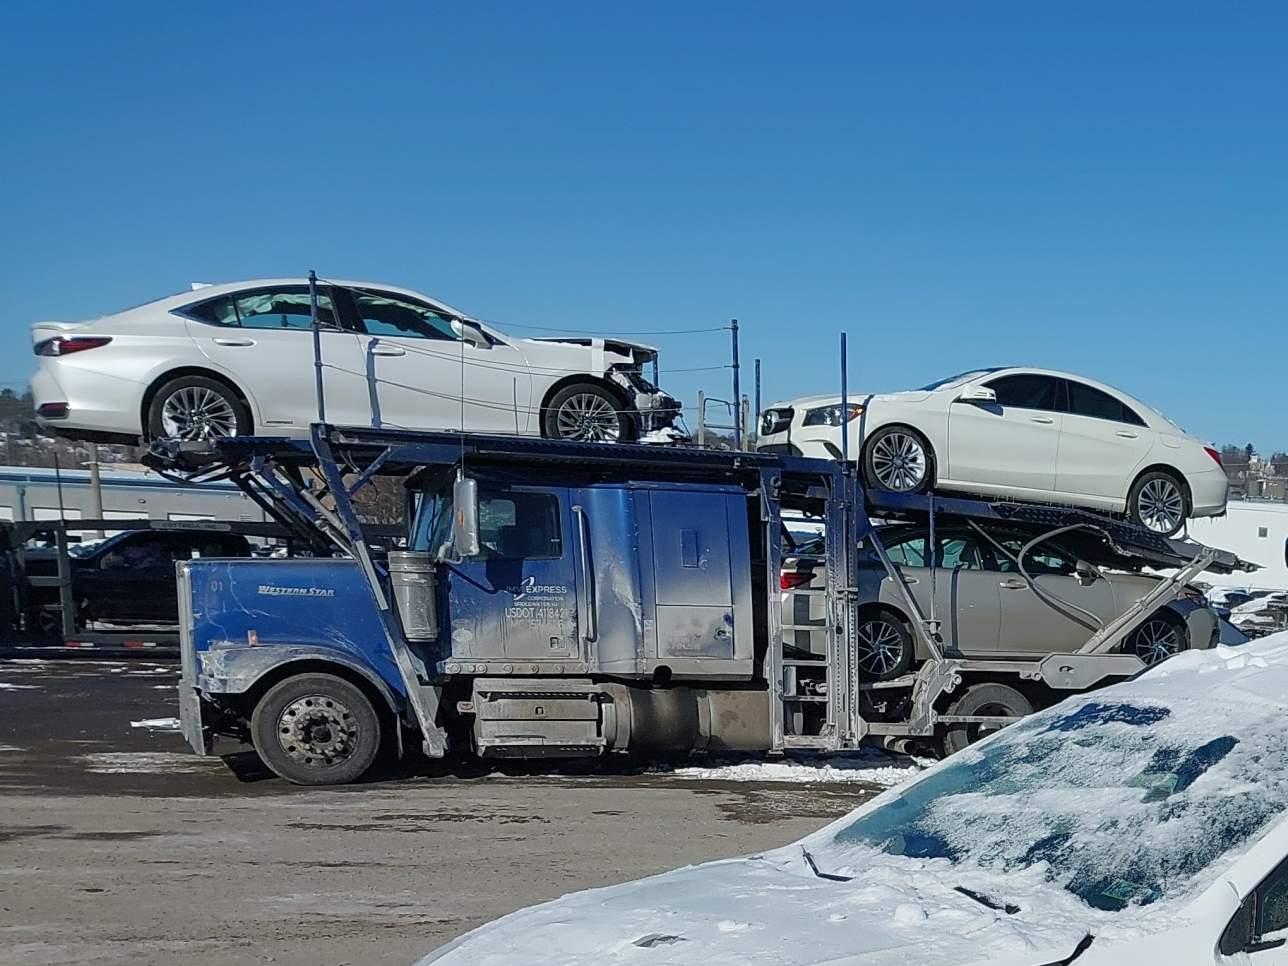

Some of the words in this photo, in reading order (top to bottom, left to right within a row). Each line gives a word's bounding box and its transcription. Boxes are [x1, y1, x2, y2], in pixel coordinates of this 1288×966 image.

[258, 585, 308, 596] WESTERN
[309, 587, 335, 597] STAR
[526, 586, 567, 594] EXPRESS
[505, 608, 535, 618] USDOT
